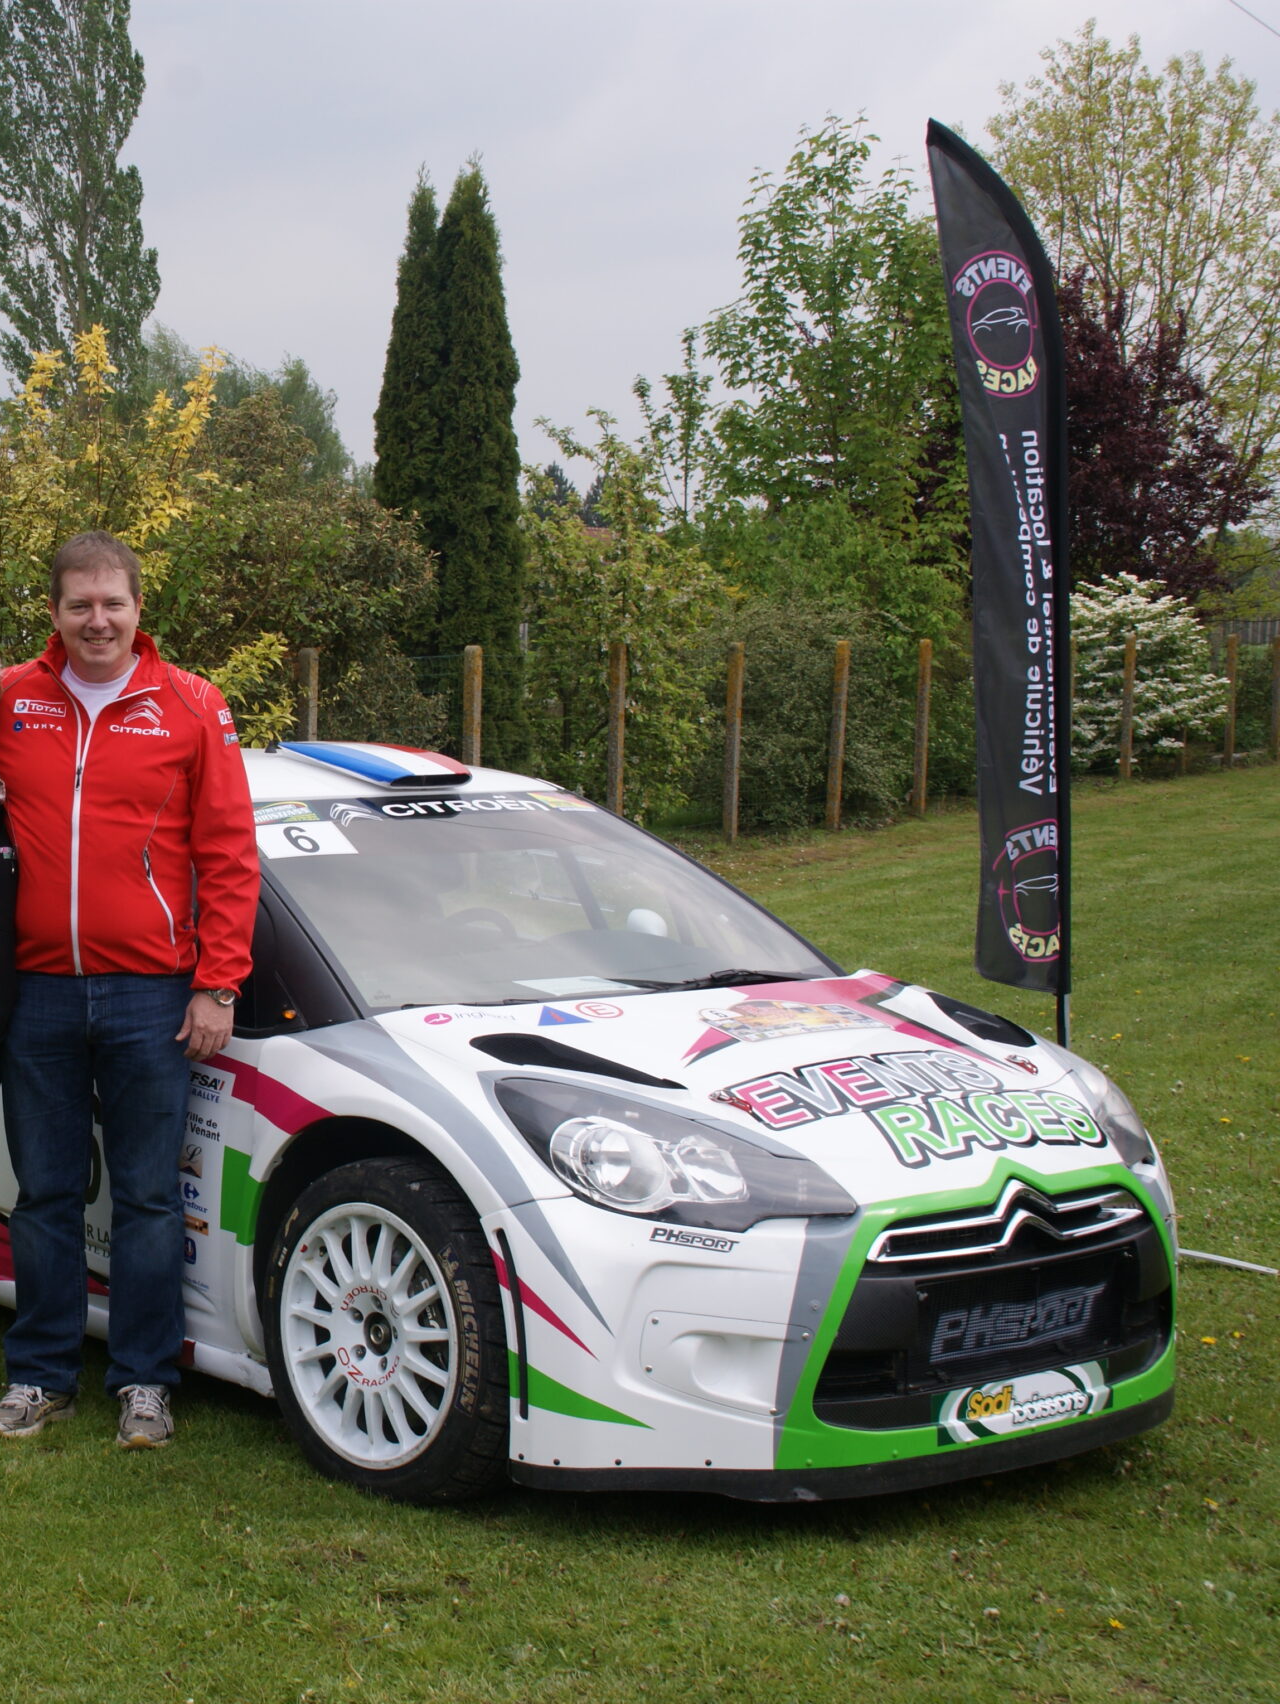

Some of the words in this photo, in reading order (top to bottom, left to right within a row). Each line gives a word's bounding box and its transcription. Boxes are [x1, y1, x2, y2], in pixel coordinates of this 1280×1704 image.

[30, 703, 65, 716] TOTAL
[283, 826, 320, 853] 6
[190, 1071, 219, 1090] FSA
[727, 1050, 1000, 1129] EVENTS
[190, 1122, 220, 1141] Venant
[206, 1120, 217, 1128] de
[875, 1090, 1106, 1167] RACES
[184, 1201, 208, 1213] refour
[649, 1227, 739, 1252] PHSPORT
[930, 1283, 1107, 1362] PHSPORT
[454, 1279, 480, 1413] MICHELIN
[361, 1355, 400, 1387] RACING
[967, 1385, 1013, 1419] Sodi
[1012, 1389, 1089, 1425] boissons
